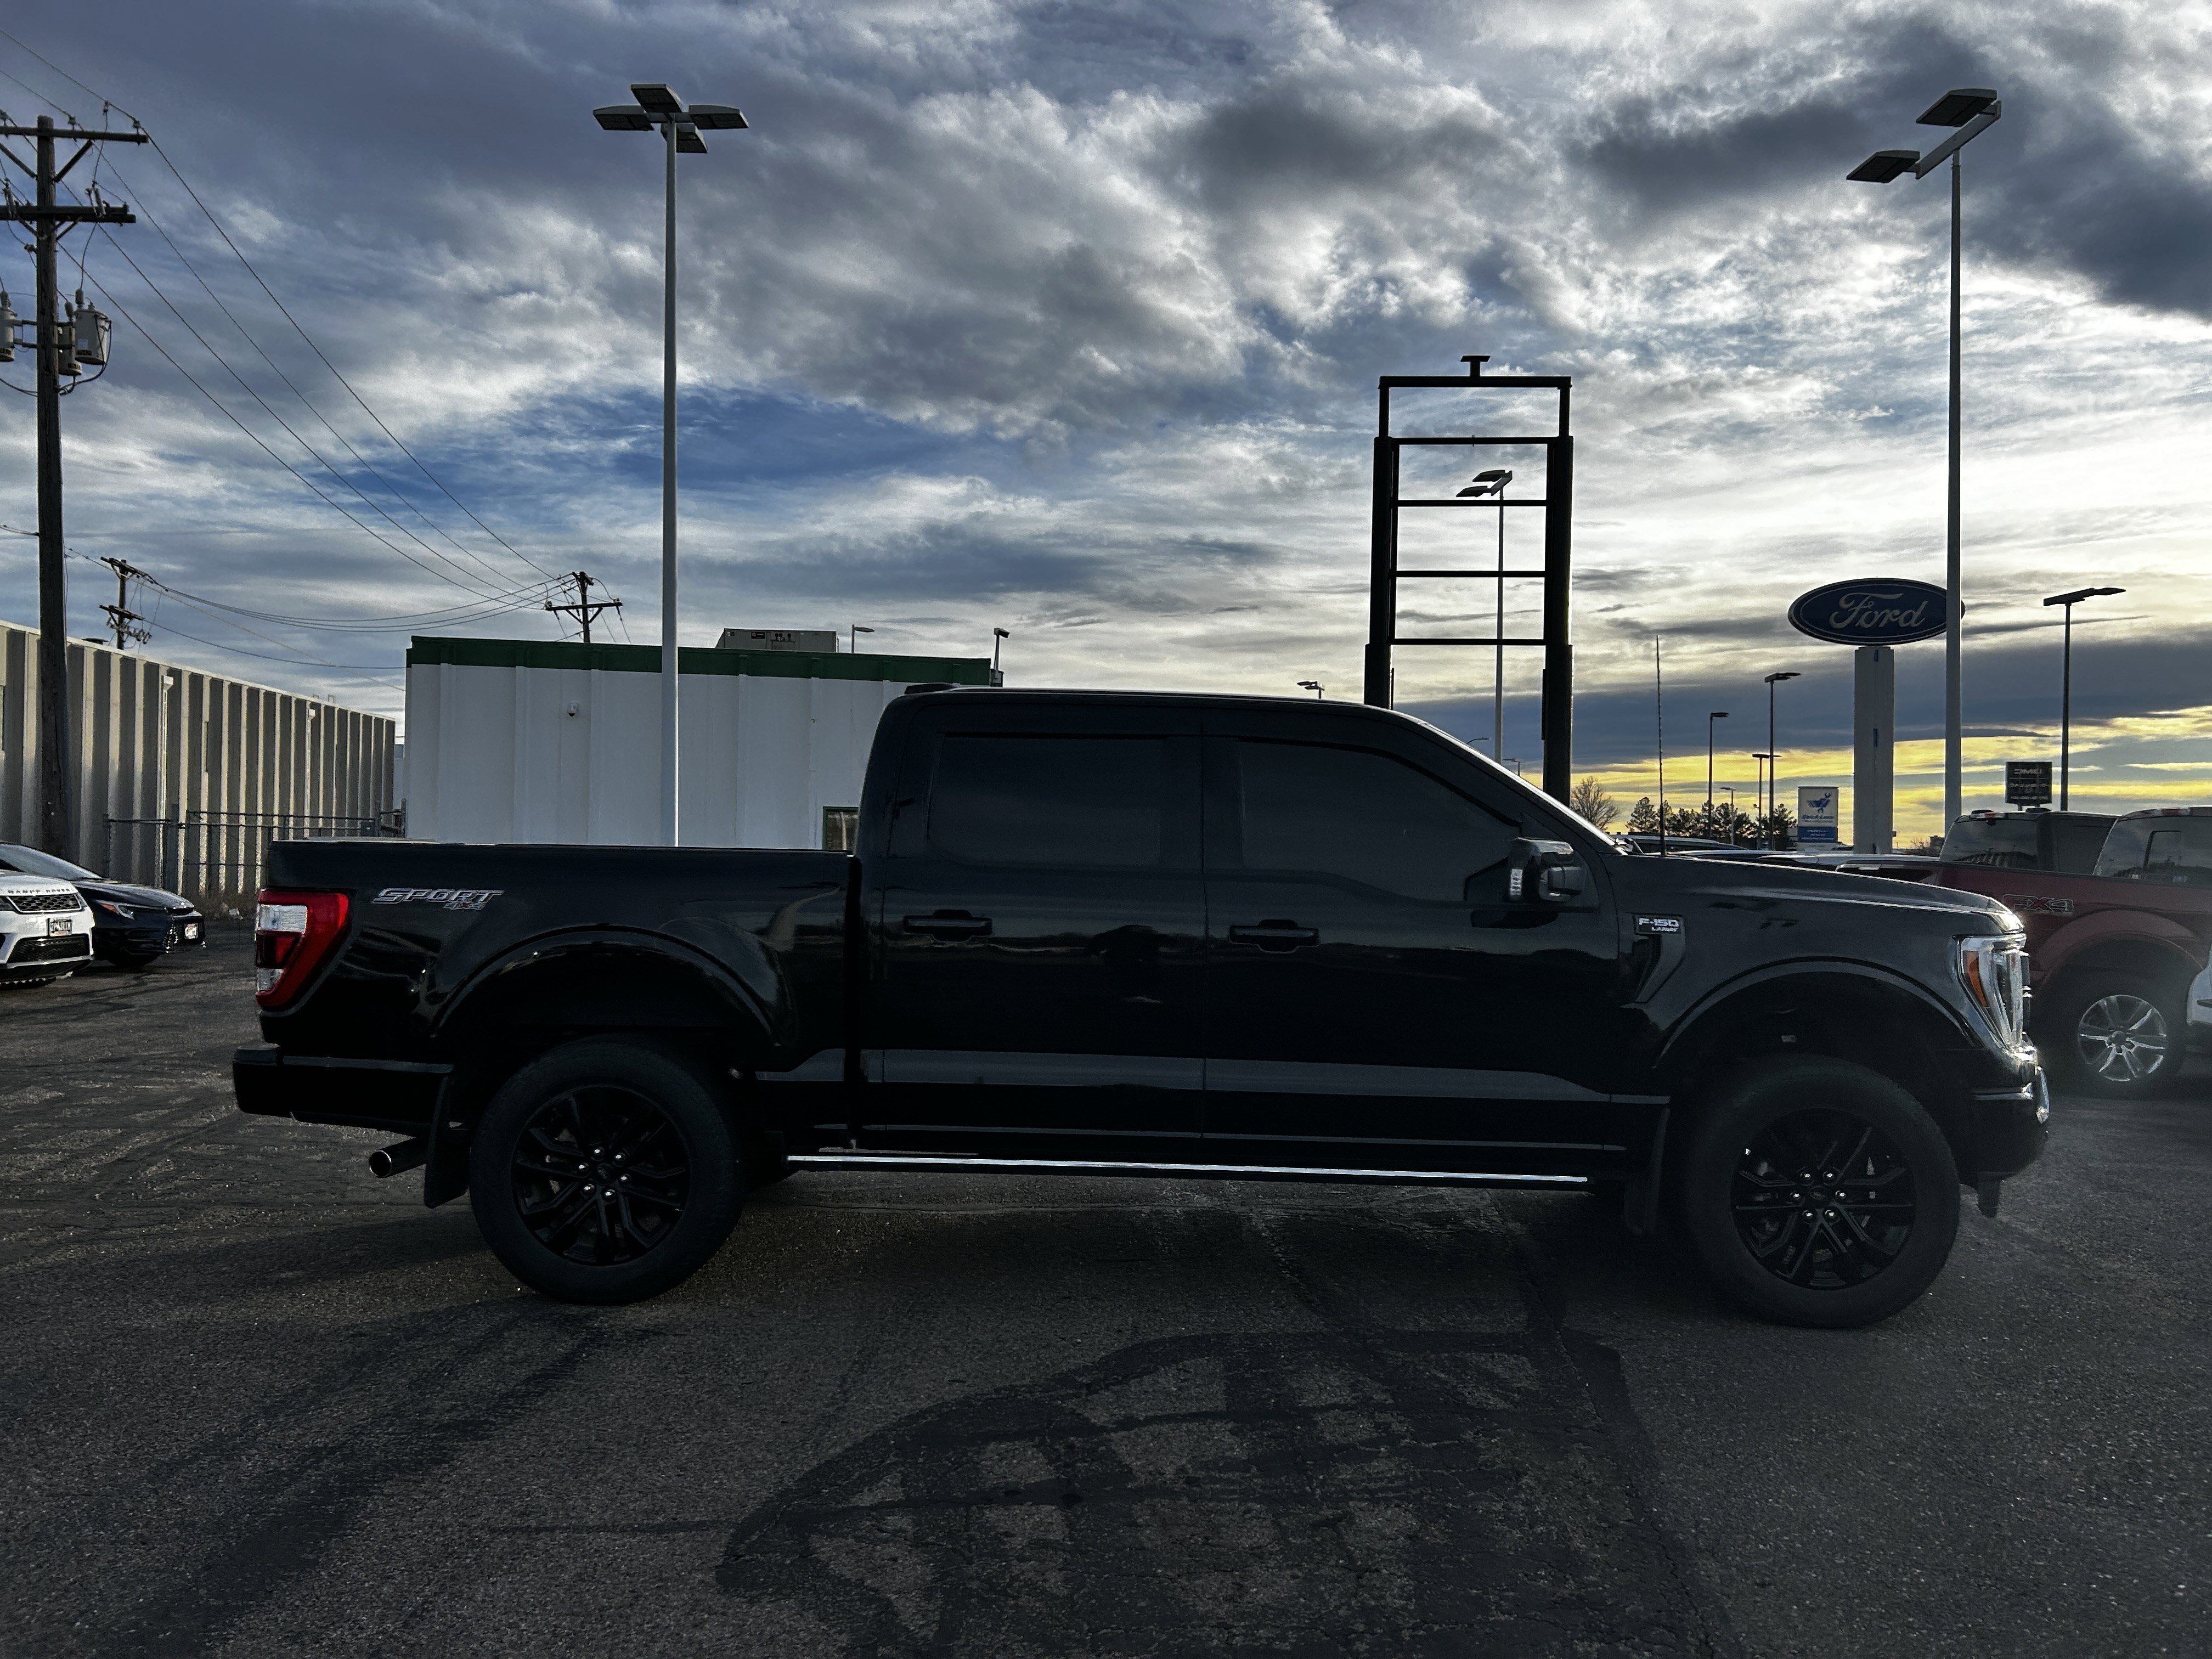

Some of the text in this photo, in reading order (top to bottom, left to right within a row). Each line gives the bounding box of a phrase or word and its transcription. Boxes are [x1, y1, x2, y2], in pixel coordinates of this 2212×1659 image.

[1829, 592, 1928, 629] Ford
[371, 888, 505, 904] SPORT
[2002, 894, 2074, 916] FX4
[1638, 918, 1679, 927] F-150
